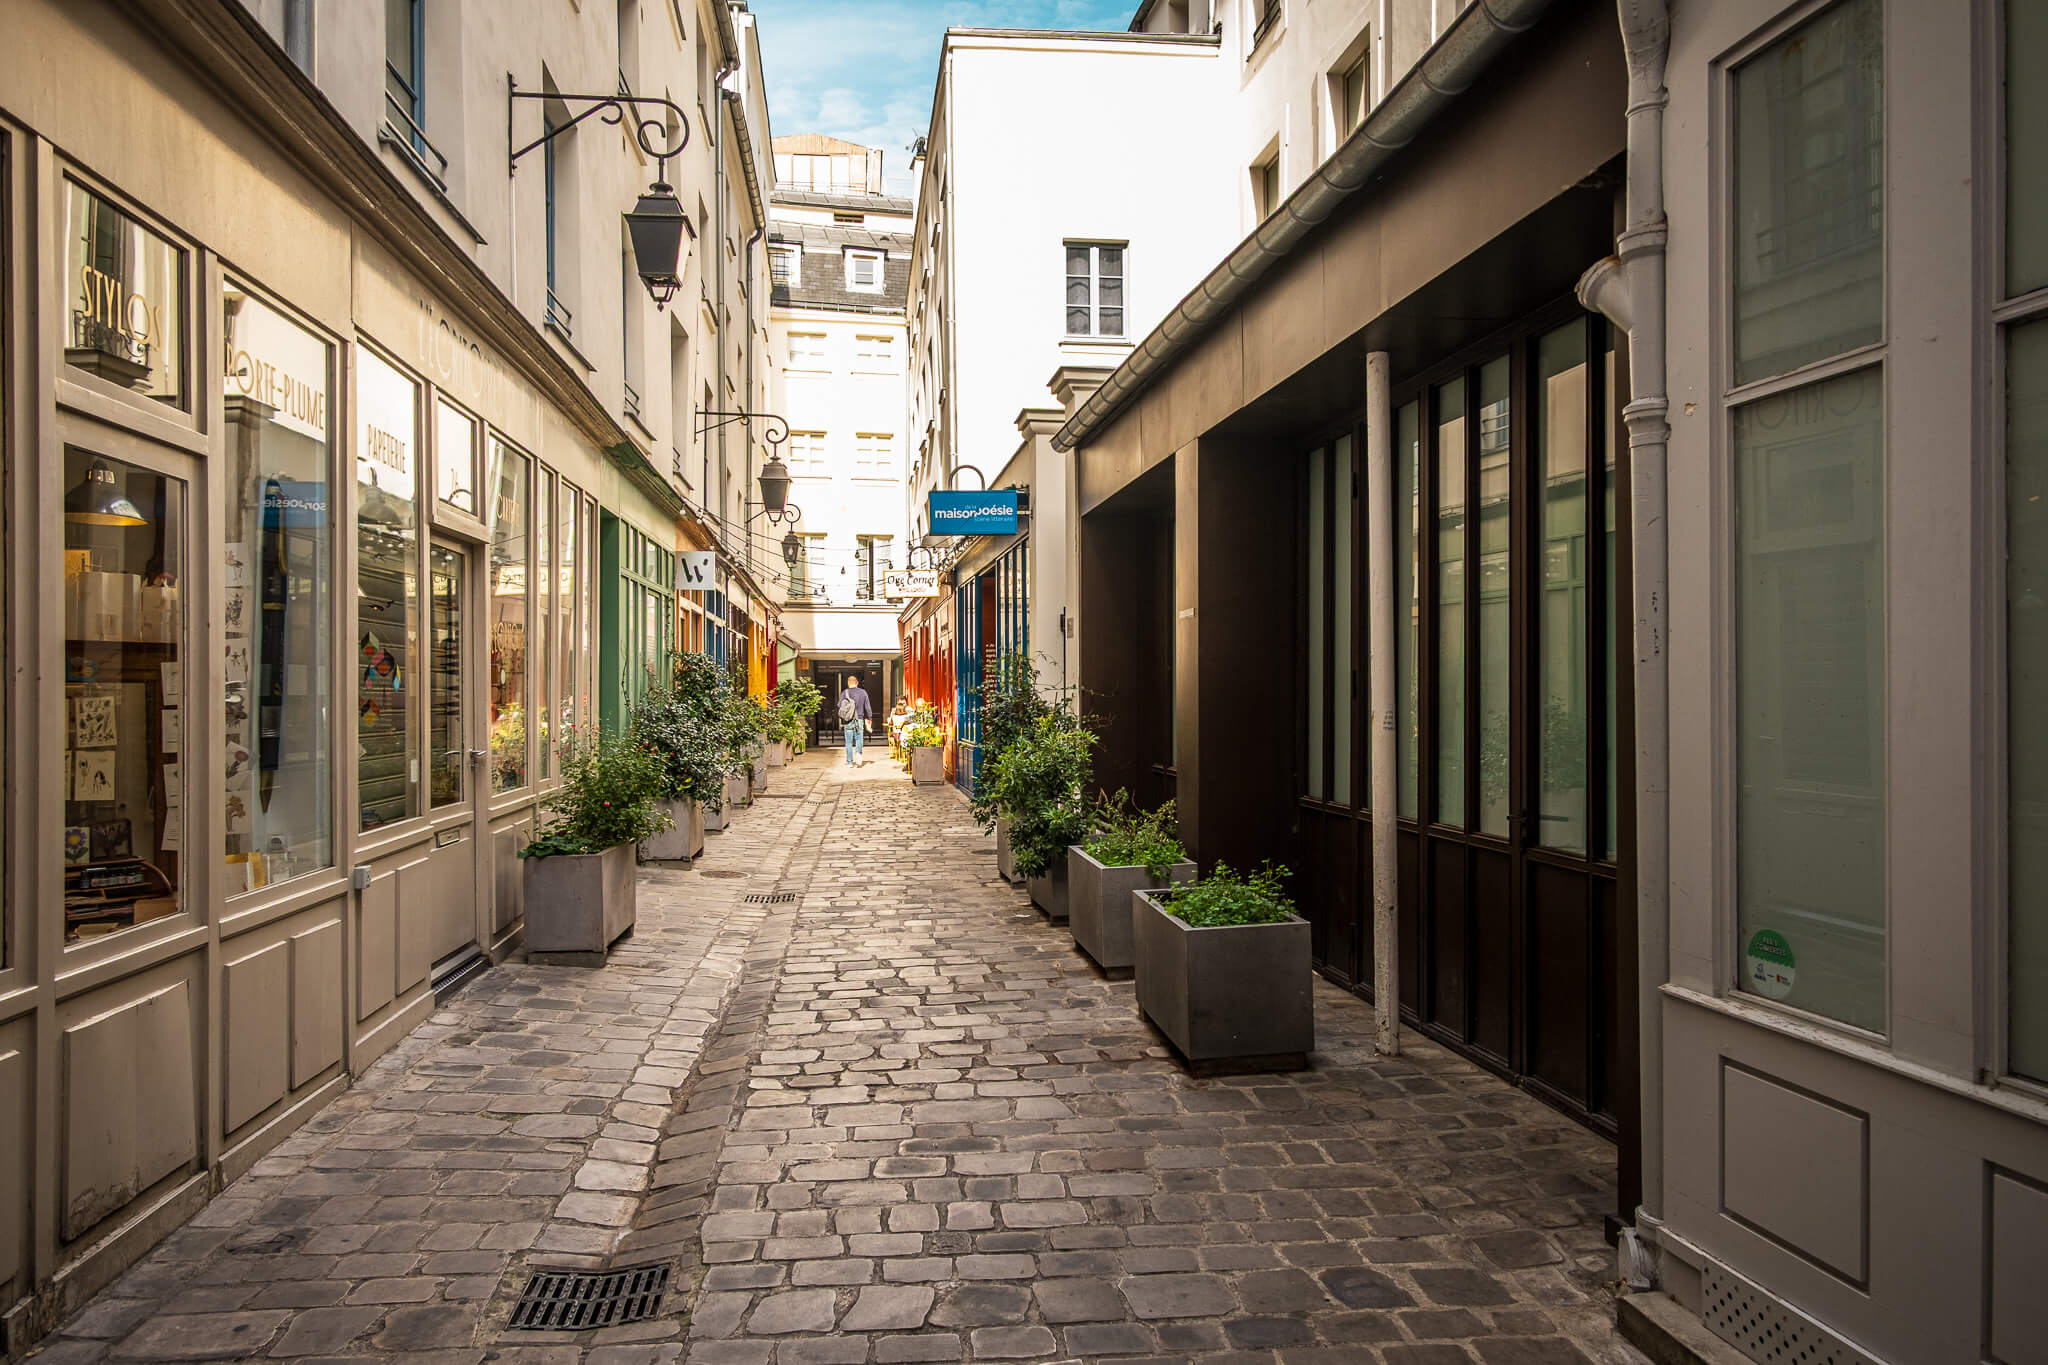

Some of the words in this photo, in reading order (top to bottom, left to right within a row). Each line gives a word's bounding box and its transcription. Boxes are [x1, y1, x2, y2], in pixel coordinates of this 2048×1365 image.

[82, 265, 161, 353] STYLOS
[225, 342, 324, 431] PORTE-PLUME
[367, 423, 406, 474] PAPETERIE
[934, 507, 977, 519] maison
